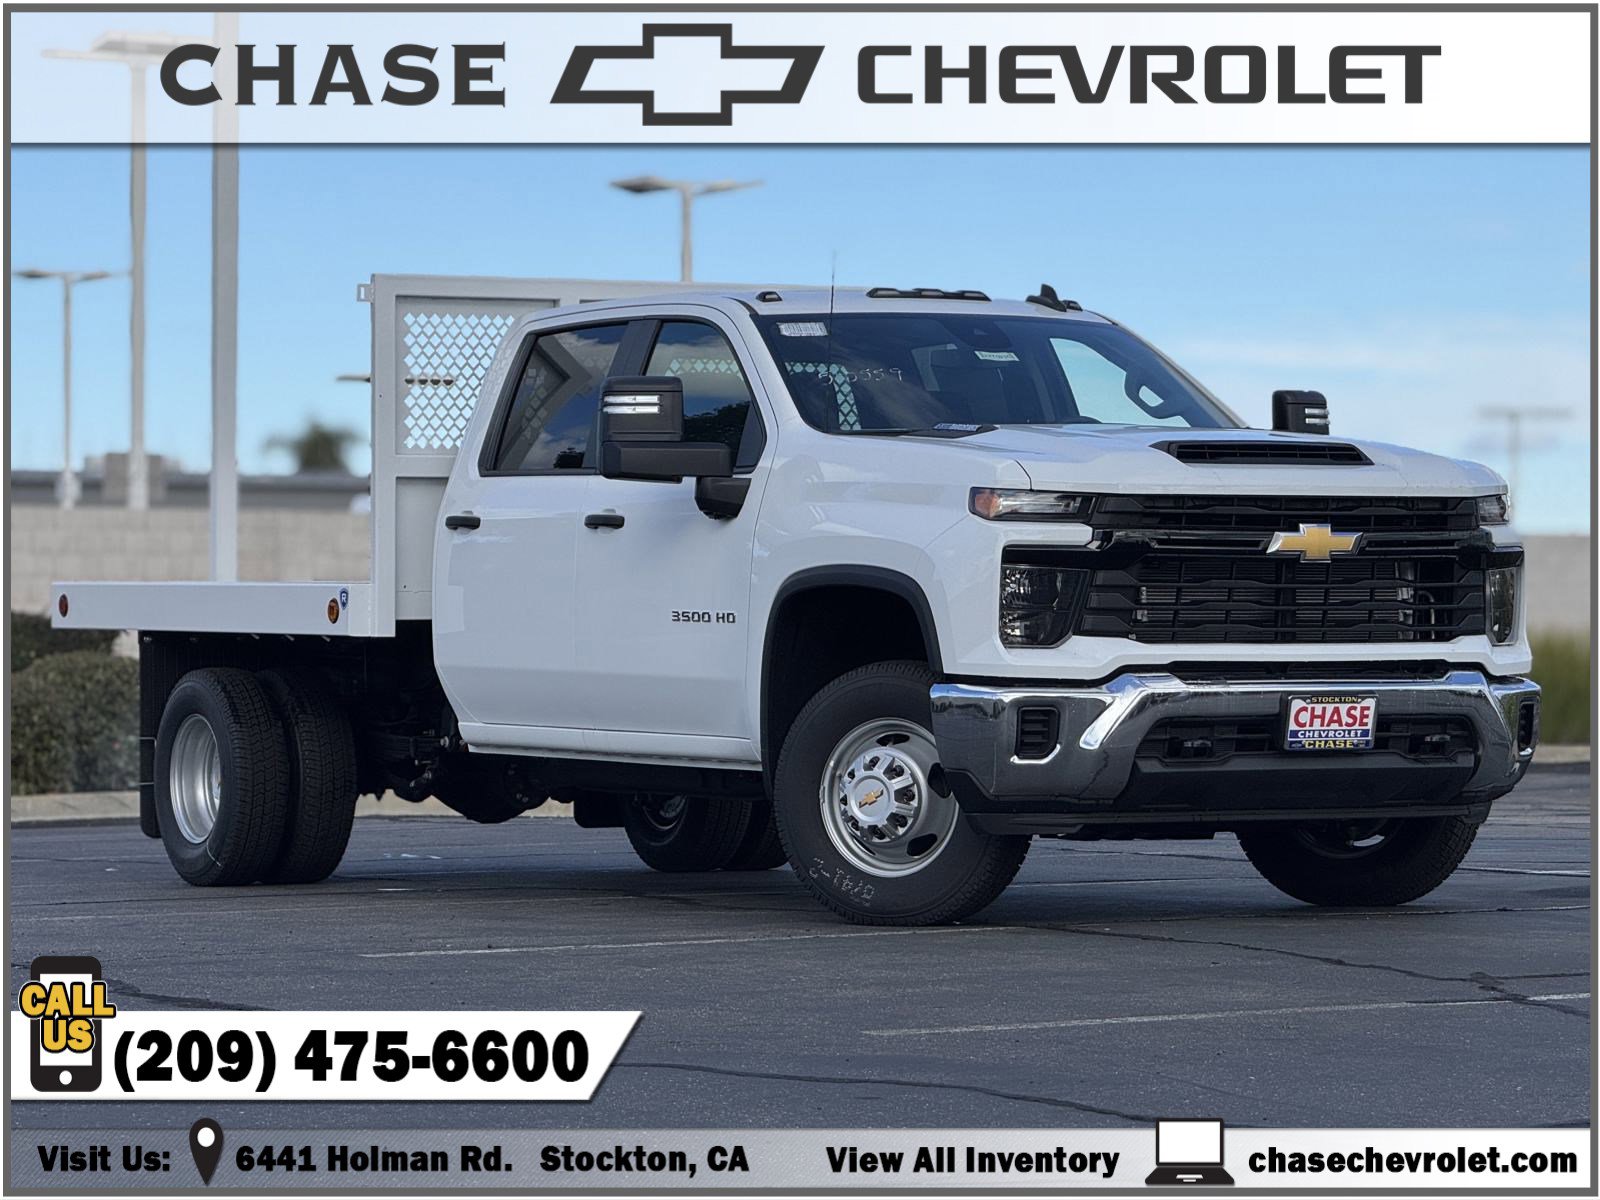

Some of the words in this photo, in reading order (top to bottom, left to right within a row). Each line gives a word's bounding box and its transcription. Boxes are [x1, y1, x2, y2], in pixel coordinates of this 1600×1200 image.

[671, 611, 711, 623] 3500
[716, 612, 736, 624] HD
[1293, 705, 1371, 728] CHASE
[1297, 730, 1362, 738] CHEVROLET
[1304, 740, 1354, 749] CHASE
